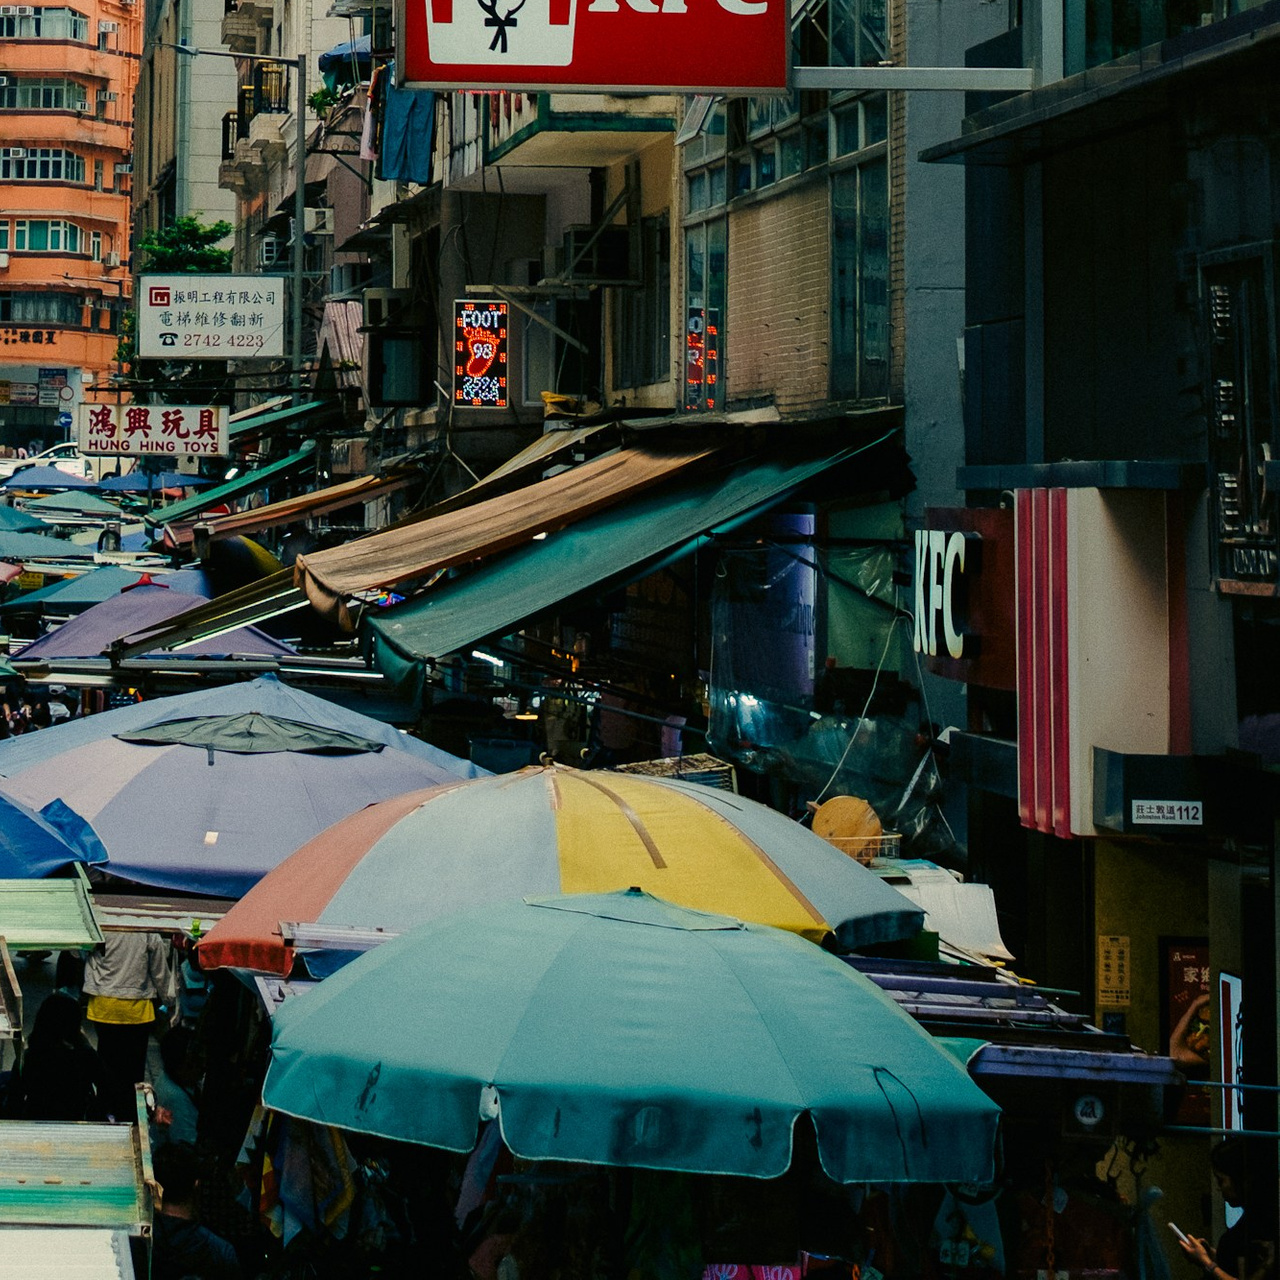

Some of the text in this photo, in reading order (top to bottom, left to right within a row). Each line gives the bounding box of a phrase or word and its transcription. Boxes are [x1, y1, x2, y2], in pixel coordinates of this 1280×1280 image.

[173, 289, 276, 306] 振明工程有限公司
[159, 311, 264, 328] 電梯維修翻新
[461, 310, 501, 329] FOOT
[183, 333, 264, 347] 2742 4223
[473, 342, 493, 359] 98
[88, 404, 219, 439] 鴻興玩具
[88, 439, 219, 453] HUNG HING TOYS
[914, 529, 966, 660] KFC
[1136, 804, 1199, 820] 莊士敦道 112
